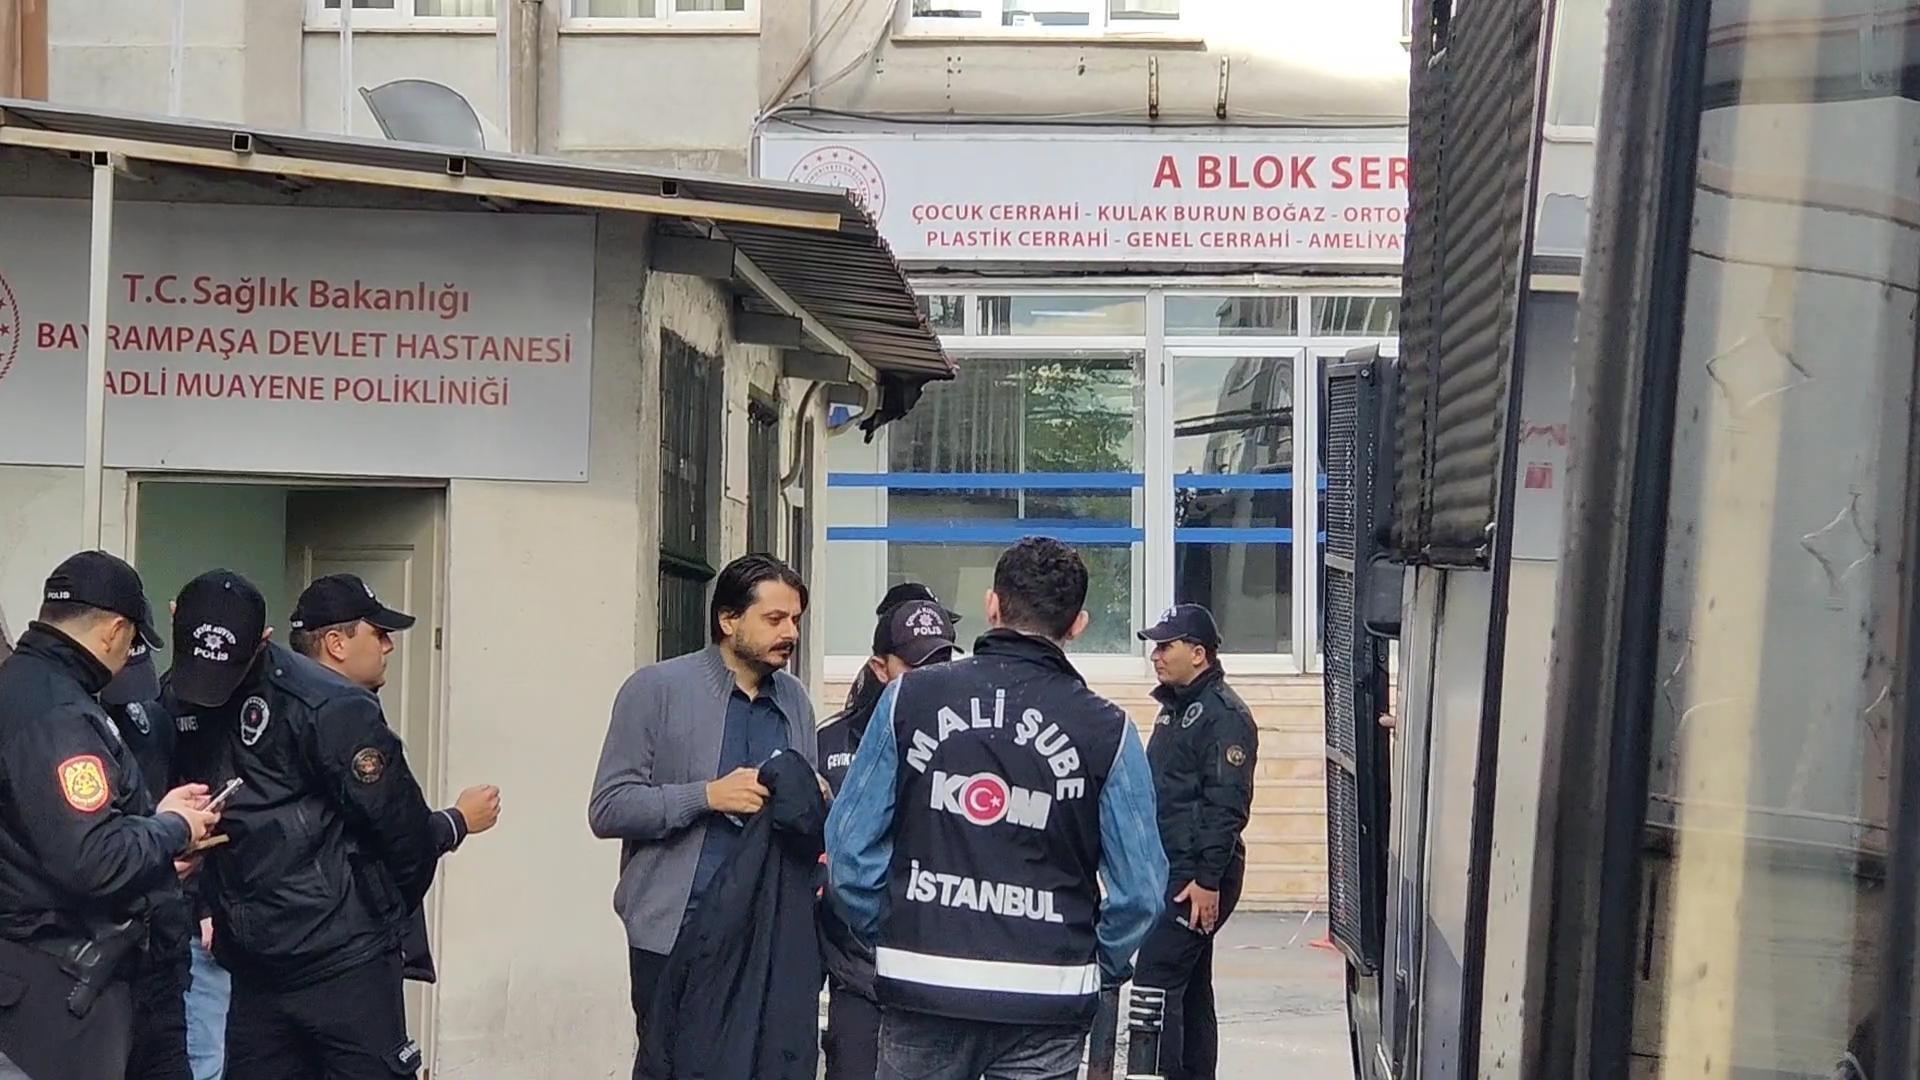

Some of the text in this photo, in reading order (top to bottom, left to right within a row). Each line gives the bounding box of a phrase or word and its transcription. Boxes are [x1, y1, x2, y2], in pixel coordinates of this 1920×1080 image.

[1153, 154, 1182, 189] A
[1197, 154, 1317, 190] BLOK
[912, 204, 984, 225] ÇOCUK
[989, 202, 1080, 221] CERRAHİ
[1098, 205, 1167, 222] KULAK
[1173, 206, 1247, 222] BURUN
[1253, 203, 1326, 223] BOĞAZ
[1343, 206, 1408, 223] ORTO
[926, 227, 1012, 247] PLASTİK
[1018, 227, 1108, 248] CERRAHİ
[1126, 231, 1193, 248] GENEL
[1200, 229, 1290, 248] CERRAHİ
[192, 275, 299, 314] Sağlık
[308, 279, 471, 320] Bakanlığı
[267, 328, 388, 360] DEVLET
[395, 332, 572, 364] HASTANESİ
[175, 372, 325, 401] MUAYENE
[333, 375, 510, 407] POLİKLİNİĞİ
[906, 689, 1085, 801] MALİ ŞUBE
[906, 859, 1064, 924] İSTANBUL
